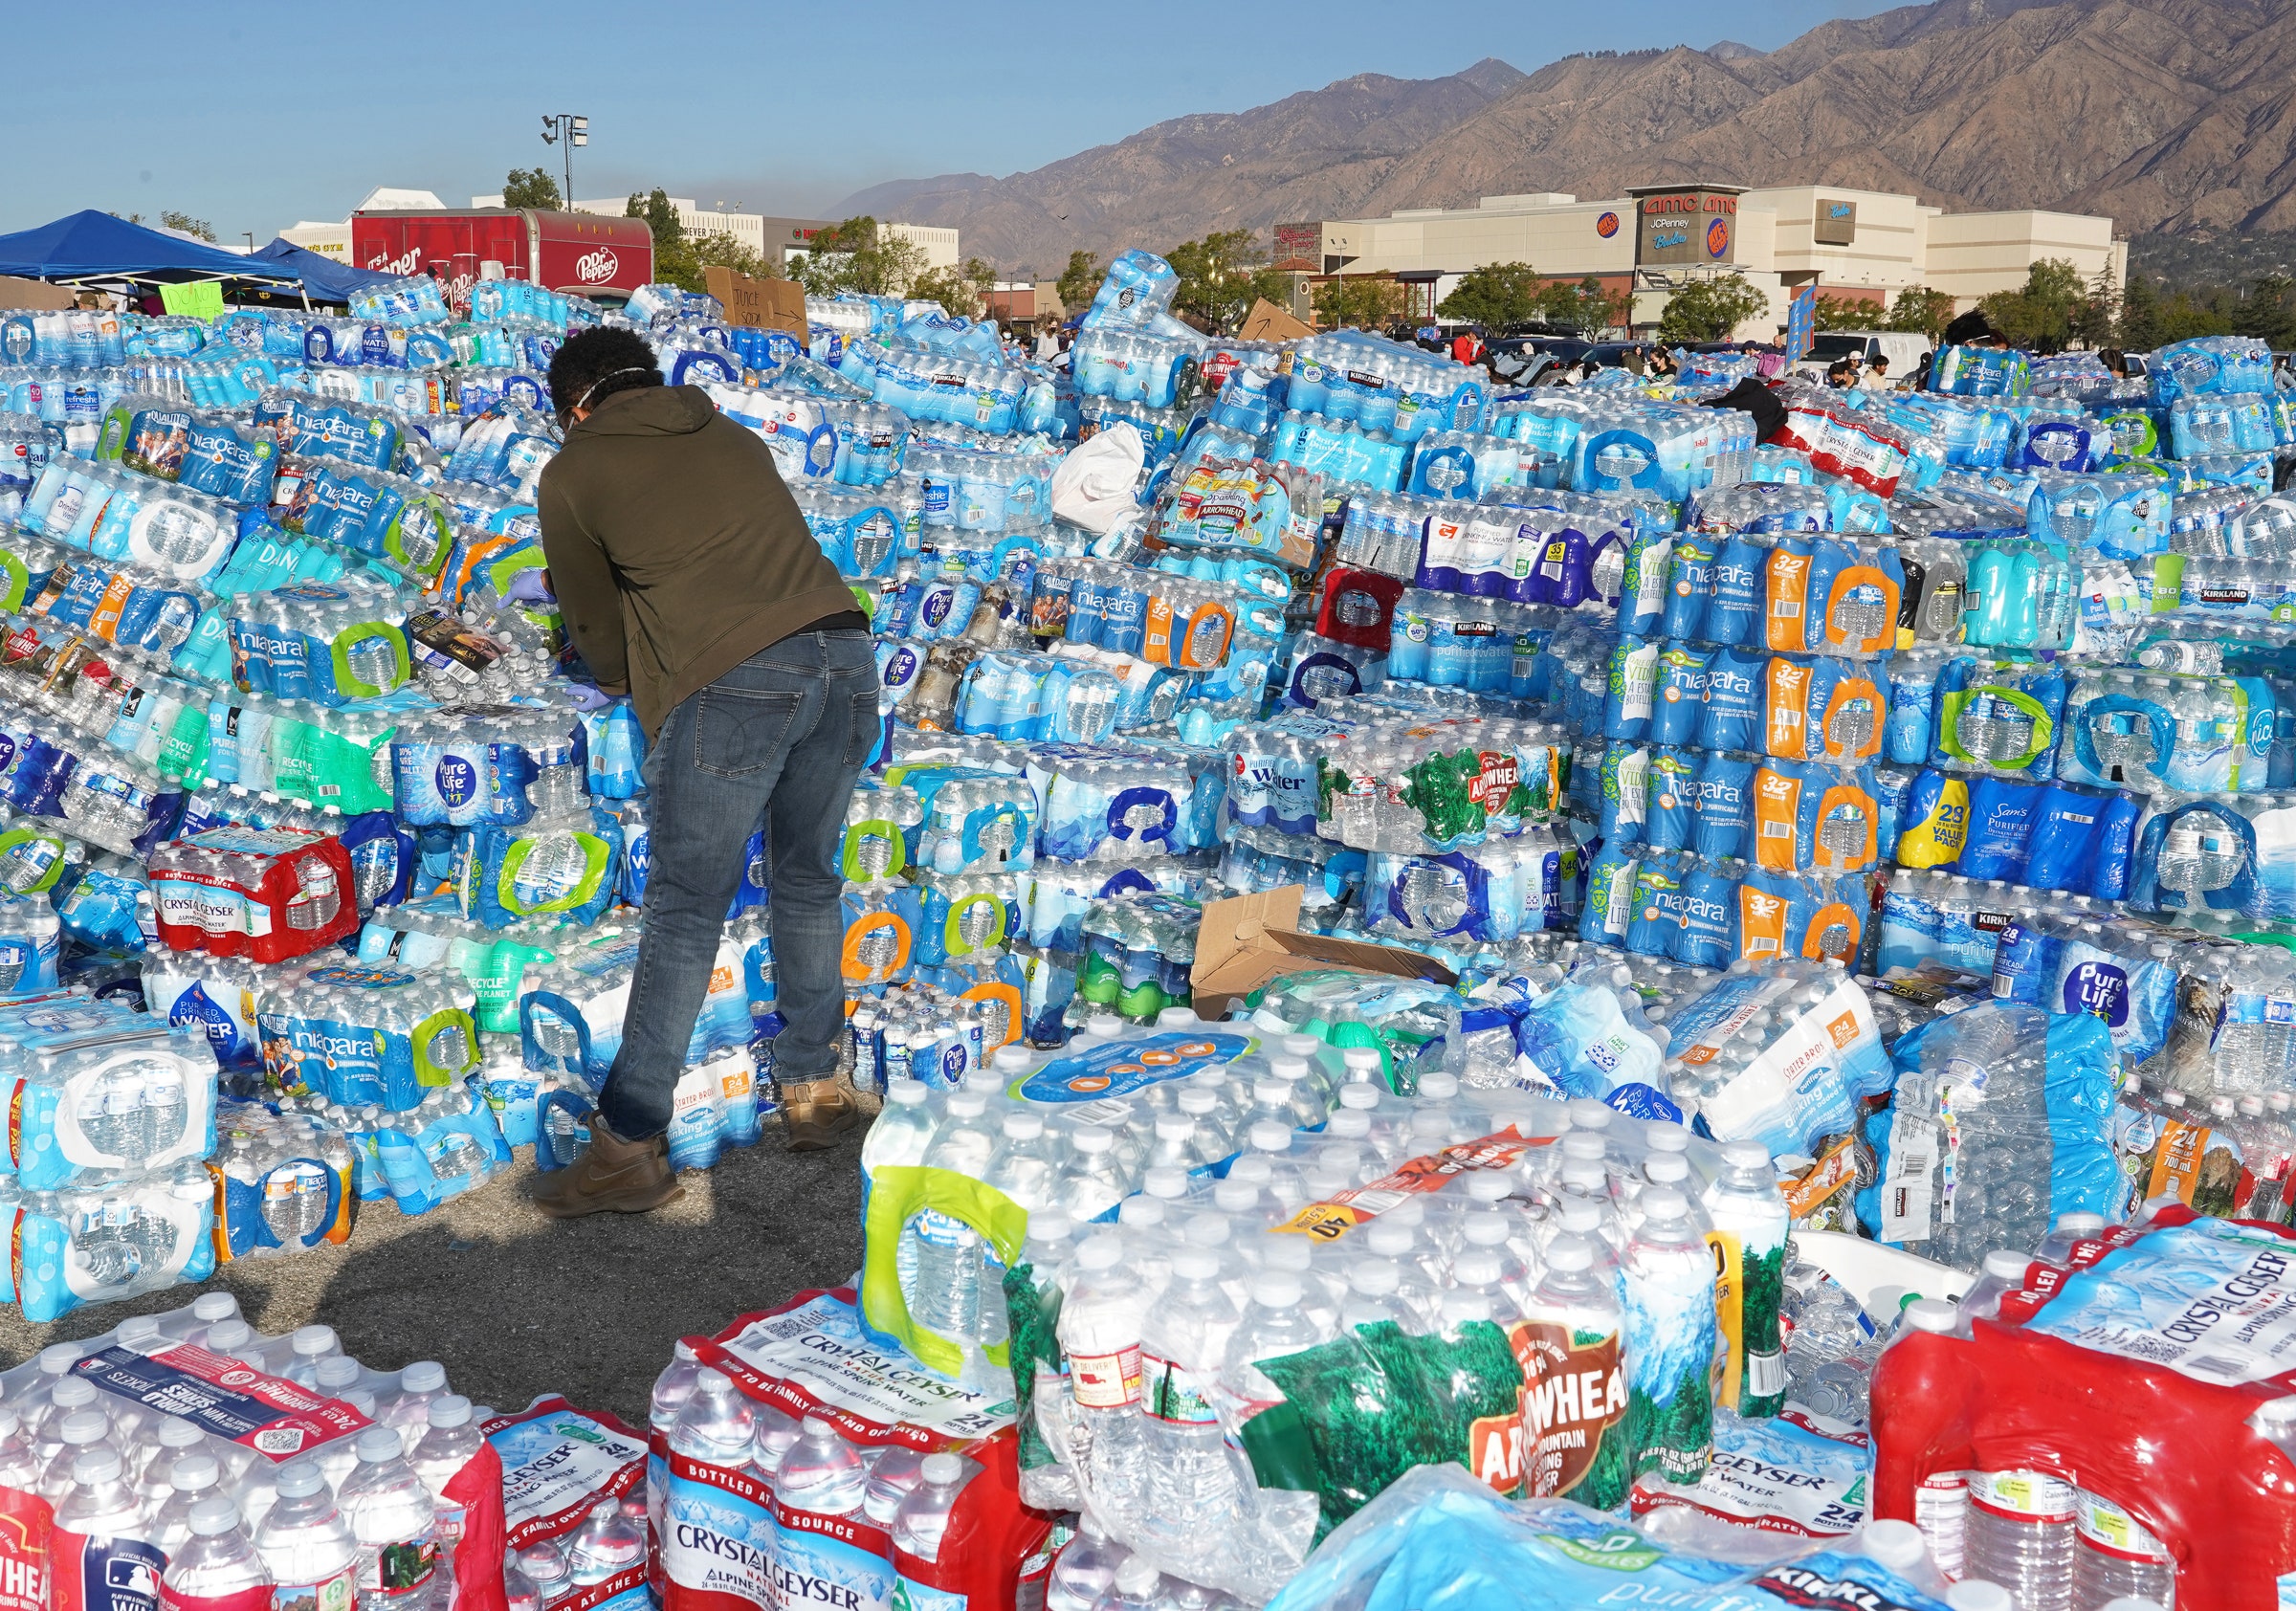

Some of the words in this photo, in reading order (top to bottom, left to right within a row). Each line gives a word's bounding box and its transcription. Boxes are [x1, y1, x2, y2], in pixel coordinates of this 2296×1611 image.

[1651, 219, 1689, 229] JCPenney
[1654, 232, 1687, 249] Bowlero
[367, 255, 381, 270] IT'S
[383, 252, 388, 262] A
[592, 252, 606, 266] Dr
[582, 255, 614, 281] Pepper
[167, 289, 190, 310] DO
[194, 286, 215, 302] NOT
[734, 289, 760, 307] JUICE
[741, 312, 761, 325] SODA
[1281, 352, 1292, 364] 40
[932, 373, 965, 386] KIRKLAND
[1350, 371, 1383, 386] KIRKLAND
[150, 410, 181, 424] QUALITY
[295, 411, 364, 442] niagara
[188, 430, 251, 462] niagara
[318, 482, 372, 509] niagara
[1207, 494, 1247, 507] Sparkling
[1201, 506, 1244, 518] ARROWHEAD
[1551, 543, 1561, 554] 35
[1774, 555, 1804, 573] 32
[1686, 564, 1755, 587] niagara
[111, 580, 130, 596] 32
[1722, 587, 1752, 598] PURIFICADA
[933, 590, 954, 605] Pure
[1078, 588, 1137, 618] niagara
[931, 604, 946, 618] Life
[1151, 602, 1170, 614] 32
[1410, 628, 1426, 636] 50%
[240, 631, 303, 657] niagara
[1629, 667, 1653, 680] VIDA
[1777, 664, 1804, 681] 32
[1675, 671, 1753, 693] niagara
[1626, 693, 1651, 705] BOTELLA
[1715, 694, 1746, 703] PURIFICADA
[209, 713, 222, 723] 40
[440, 762, 466, 774] Pure
[442, 776, 465, 792] Life
[1623, 771, 1646, 785] VIDA
[1762, 776, 1793, 794] 32
[1668, 778, 1741, 805] niagara
[1708, 803, 1737, 813] PURIFICADA
[1940, 804, 1965, 824] 28
[1991, 804, 2027, 817] Sam's
[1988, 817, 2030, 830] PURIFIED
[1933, 827, 1963, 841] VALUE
[1933, 836, 1960, 850] PACK
[201, 904, 234, 916] GEYSER
[1654, 893, 1725, 921] niagara
[1750, 894, 1780, 914] 32
[1689, 920, 1712, 930] DRINKING
[2003, 927, 2019, 938] 28
[367, 937, 385, 949] 40
[710, 972, 726, 984] 24
[2078, 964, 2124, 992] Pure
[2081, 984, 2116, 1009] Life
[1834, 1021, 1849, 1036] 24
[296, 1031, 375, 1059] niagara
[1783, 1058, 1804, 1084] STATER
[1805, 1042, 1824, 1060] BROS
[728, 1078, 743, 1089] 24
[1799, 1070, 1823, 1092] purified
[684, 1108, 709, 1123] purified
[1785, 1087, 1822, 1129] drinking
[2174, 1130, 2197, 1148] 24
[2164, 1155, 2178, 1167] 700
[2178, 1160, 2192, 1173] mL
[1895, 1187, 1907, 1217] KIRKLAND
[1312, 1216, 1350, 1238] 40
[107, 1371, 155, 1392] TICKETS
[800, 1357, 840, 1374] ALPINE
[883, 1384, 928, 1407] WATER
[889, 1370, 982, 1404] GEYSER
[142, 1391, 196, 1415] WORLD
[162, 1384, 218, 1408] SERIES
[740, 1372, 759, 1385] TO
[758, 1381, 775, 1393] BE
[775, 1385, 807, 1412] FAMILY
[836, 1414, 866, 1433] AND
[338, 1412, 360, 1430] 24
[953, 1414, 995, 1430] 24
[599, 1444, 629, 1456] 24
[502, 1443, 579, 1487] GEYSER
[1662, 1459, 1686, 1473] TOTAL
[1721, 1453, 1828, 1491] GEYSER
[688, 1464, 754, 1495] BOTTLED
[759, 1490, 771, 1504] AT
[792, 1514, 855, 1540] SOURCE
[1820, 1503, 1861, 1524] 24
[1813, 1517, 1854, 1530] BOTTLES
[119, 1552, 141, 1561] OFFICIAL
[676, 1524, 773, 1580] CRYSTAL
[772, 1564, 860, 1611] GEYSER
[705, 1568, 754, 1590] ALPINE
[581, 1591, 596, 1609] AT
[607, 1576, 631, 1593] THE
[746, 1569, 790, 1607] NATURAL
